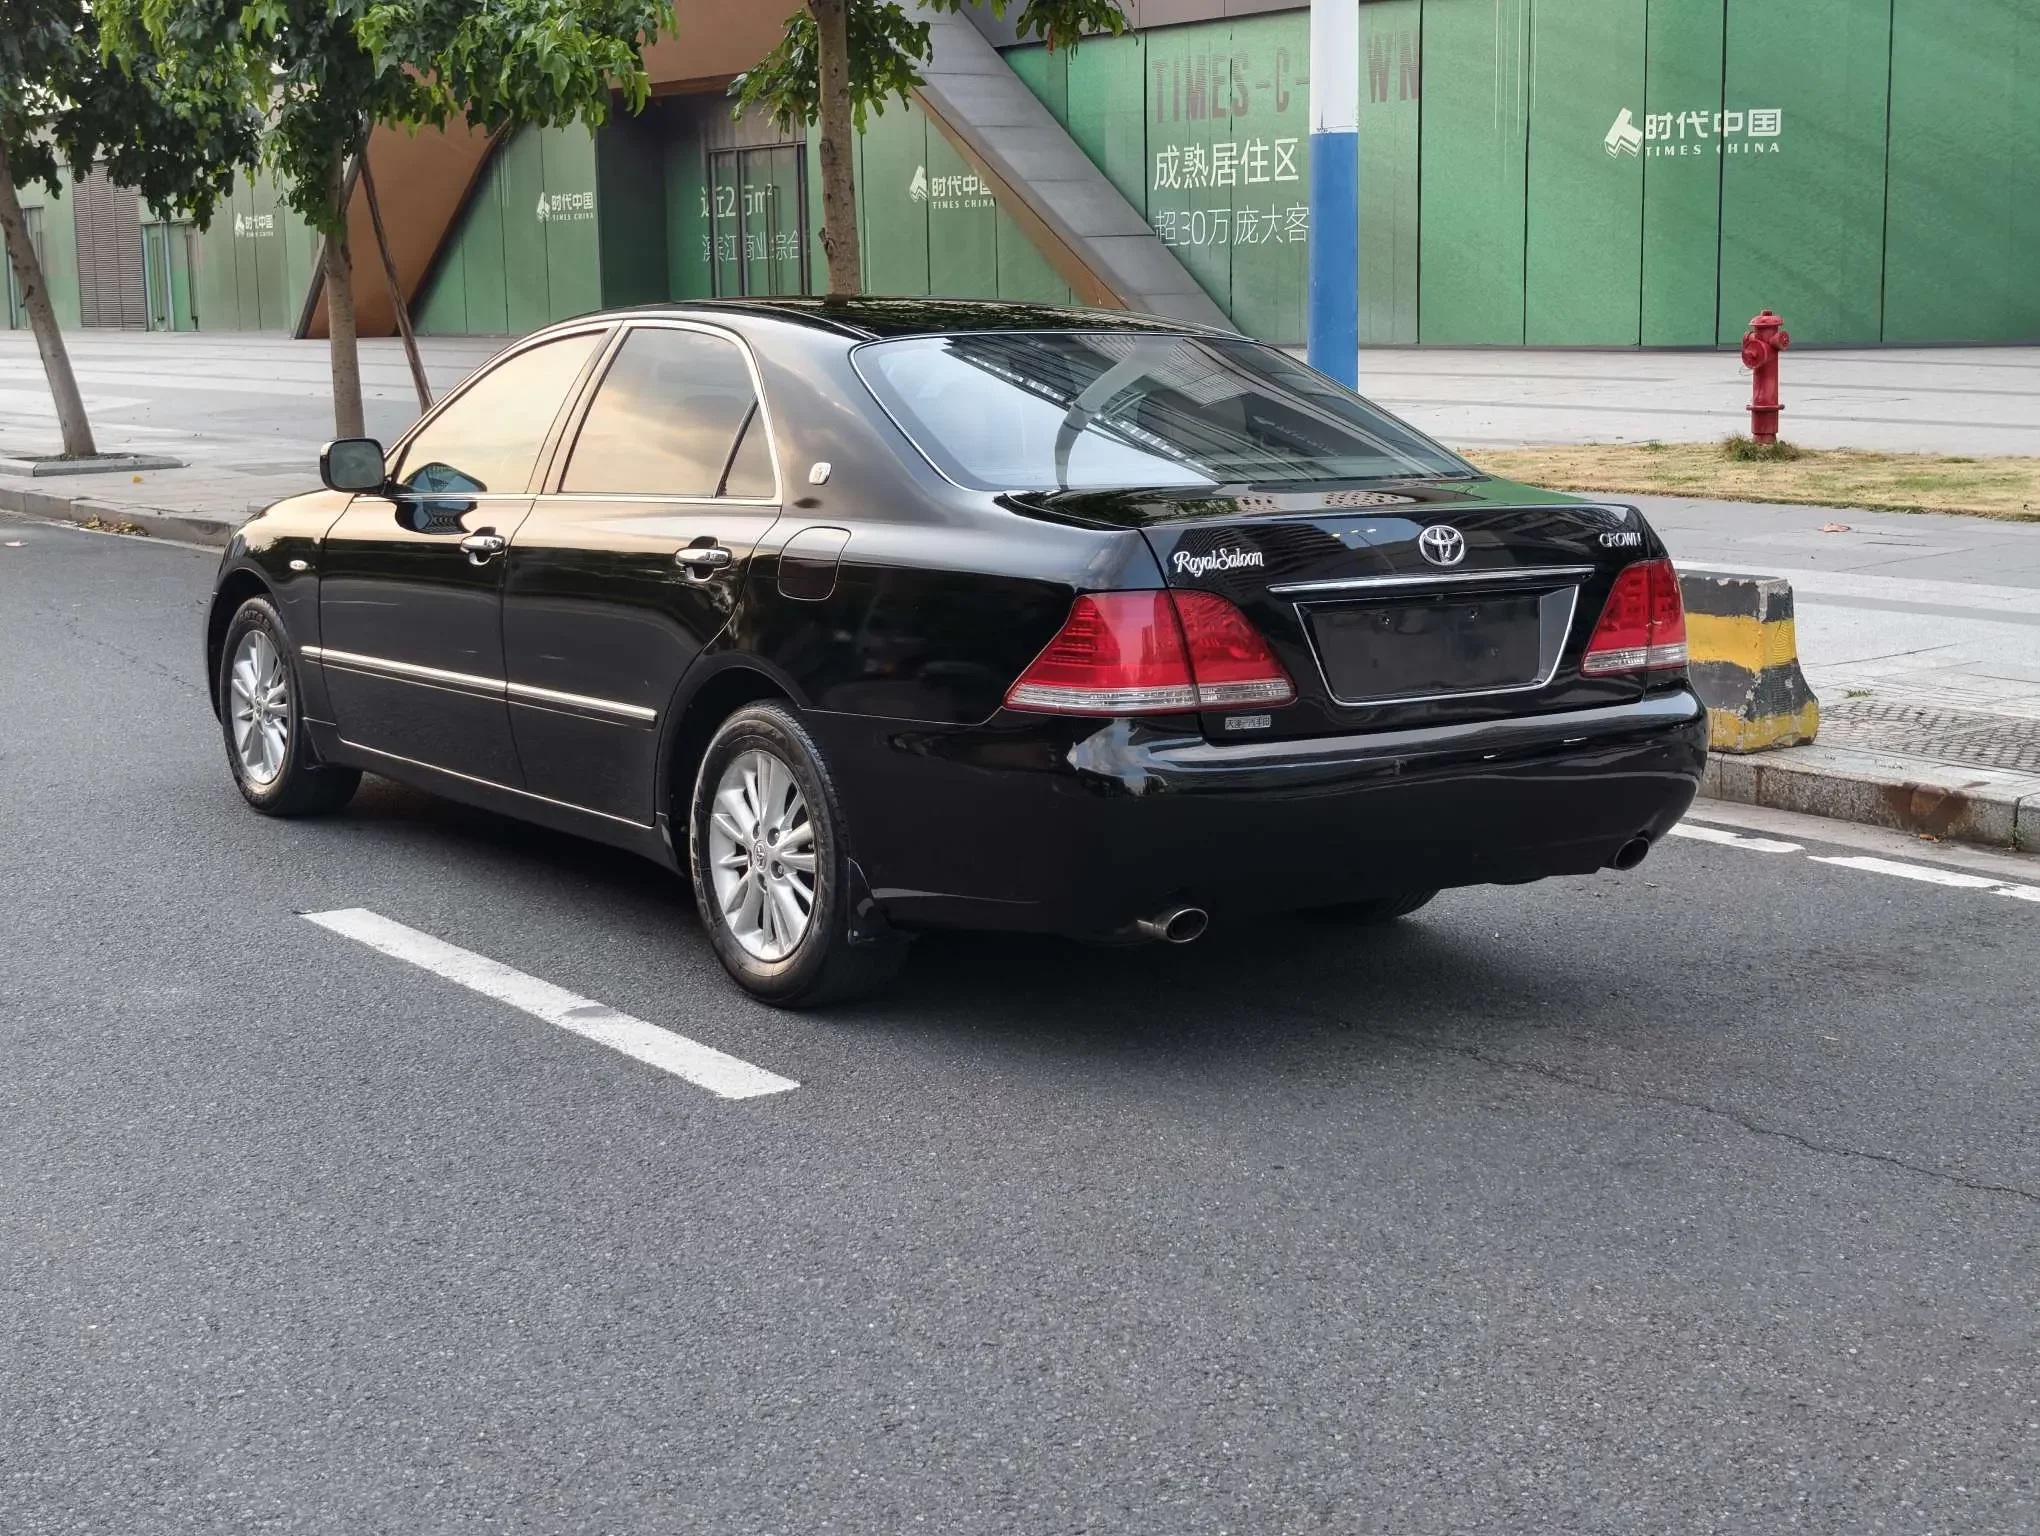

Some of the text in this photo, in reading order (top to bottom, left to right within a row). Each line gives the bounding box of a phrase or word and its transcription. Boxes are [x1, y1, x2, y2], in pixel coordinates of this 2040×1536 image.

[1645, 108, 1782, 140] 时代中国
[1646, 142, 1780, 157] TIMES CHINA
[1153, 137, 1300, 191] 成熟居住区
[551, 191, 594, 211] 时代中国
[932, 198, 995, 209] TIMES CHINA
[1599, 532, 1641, 547] CROWN
